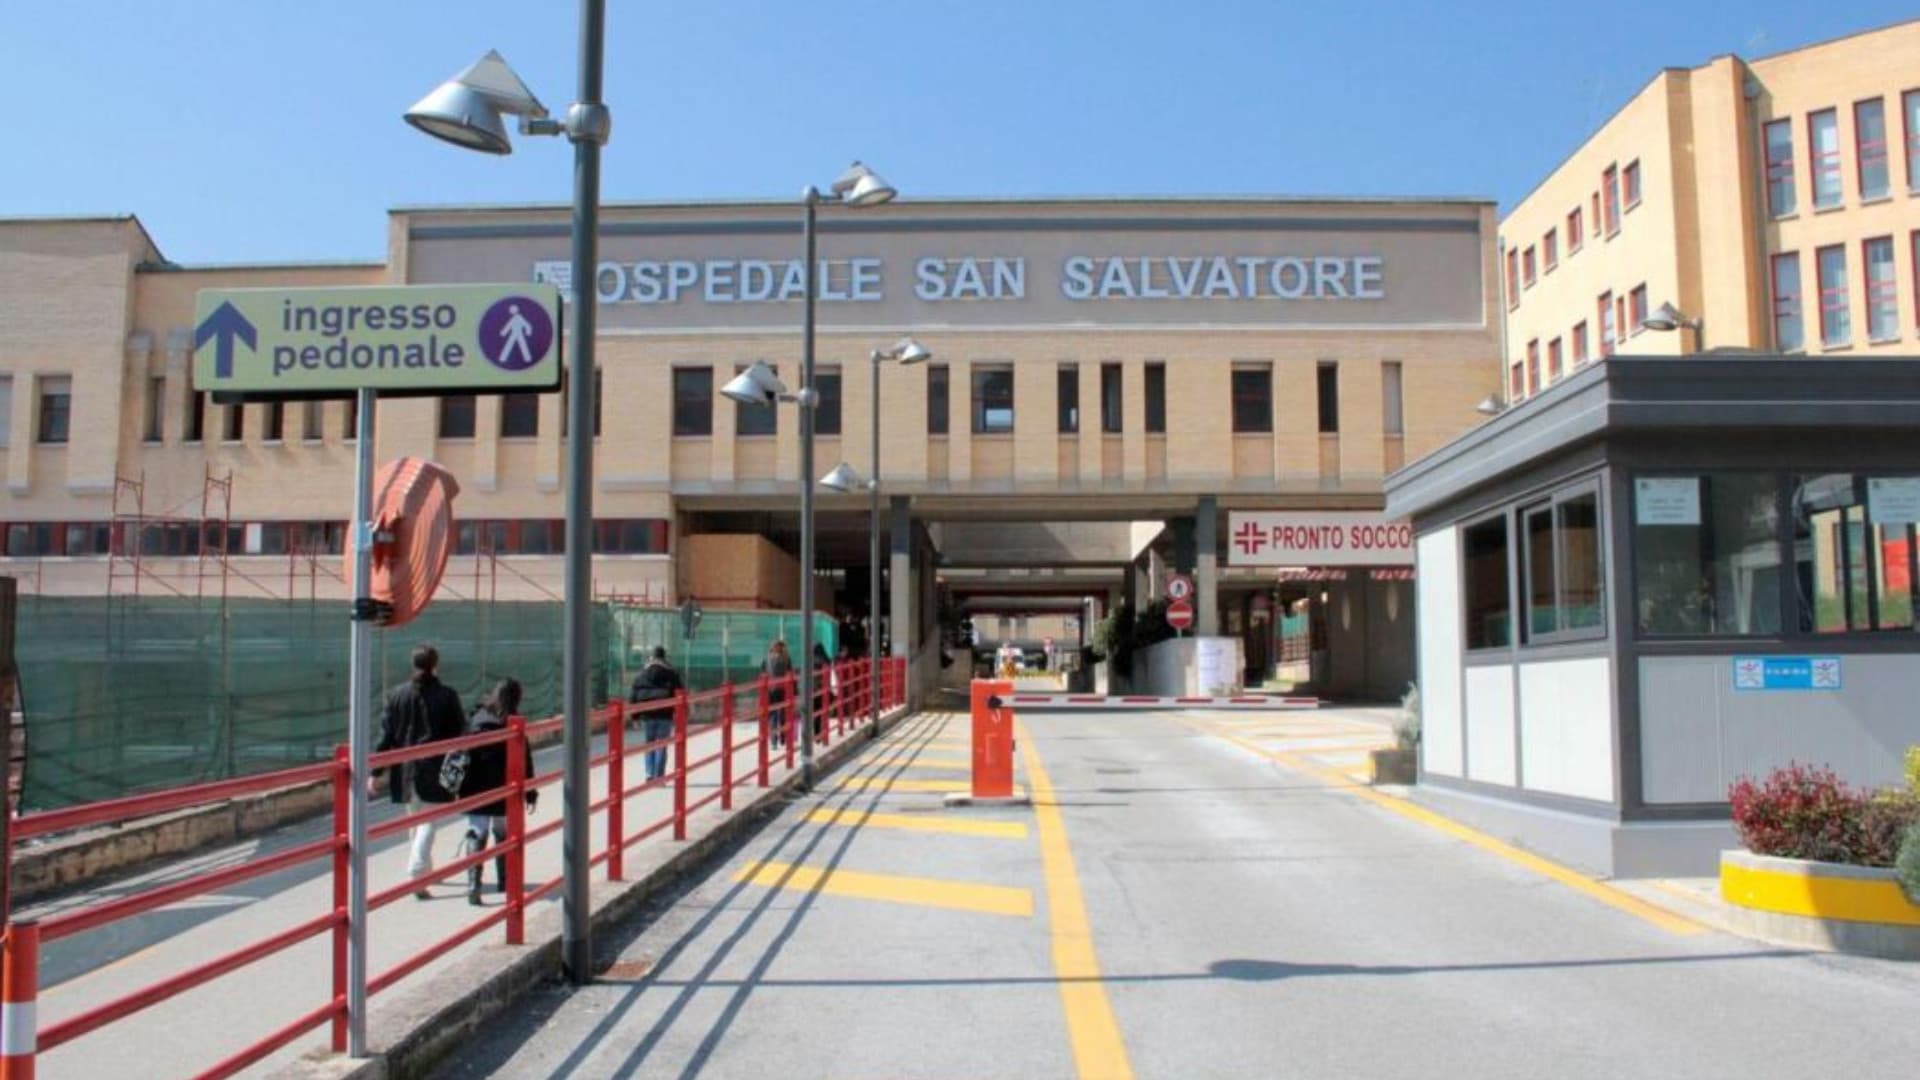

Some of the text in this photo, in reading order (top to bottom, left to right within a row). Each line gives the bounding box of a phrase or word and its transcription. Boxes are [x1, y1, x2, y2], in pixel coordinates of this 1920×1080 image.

[595, 258, 881, 303] OSPEDALE
[914, 256, 1026, 300] SAN
[1062, 255, 1385, 300] SALVATORE
[282, 299, 457, 335] ingresso
[273, 335, 465, 376] pedonale
[1271, 525, 1343, 549] PRONTO
